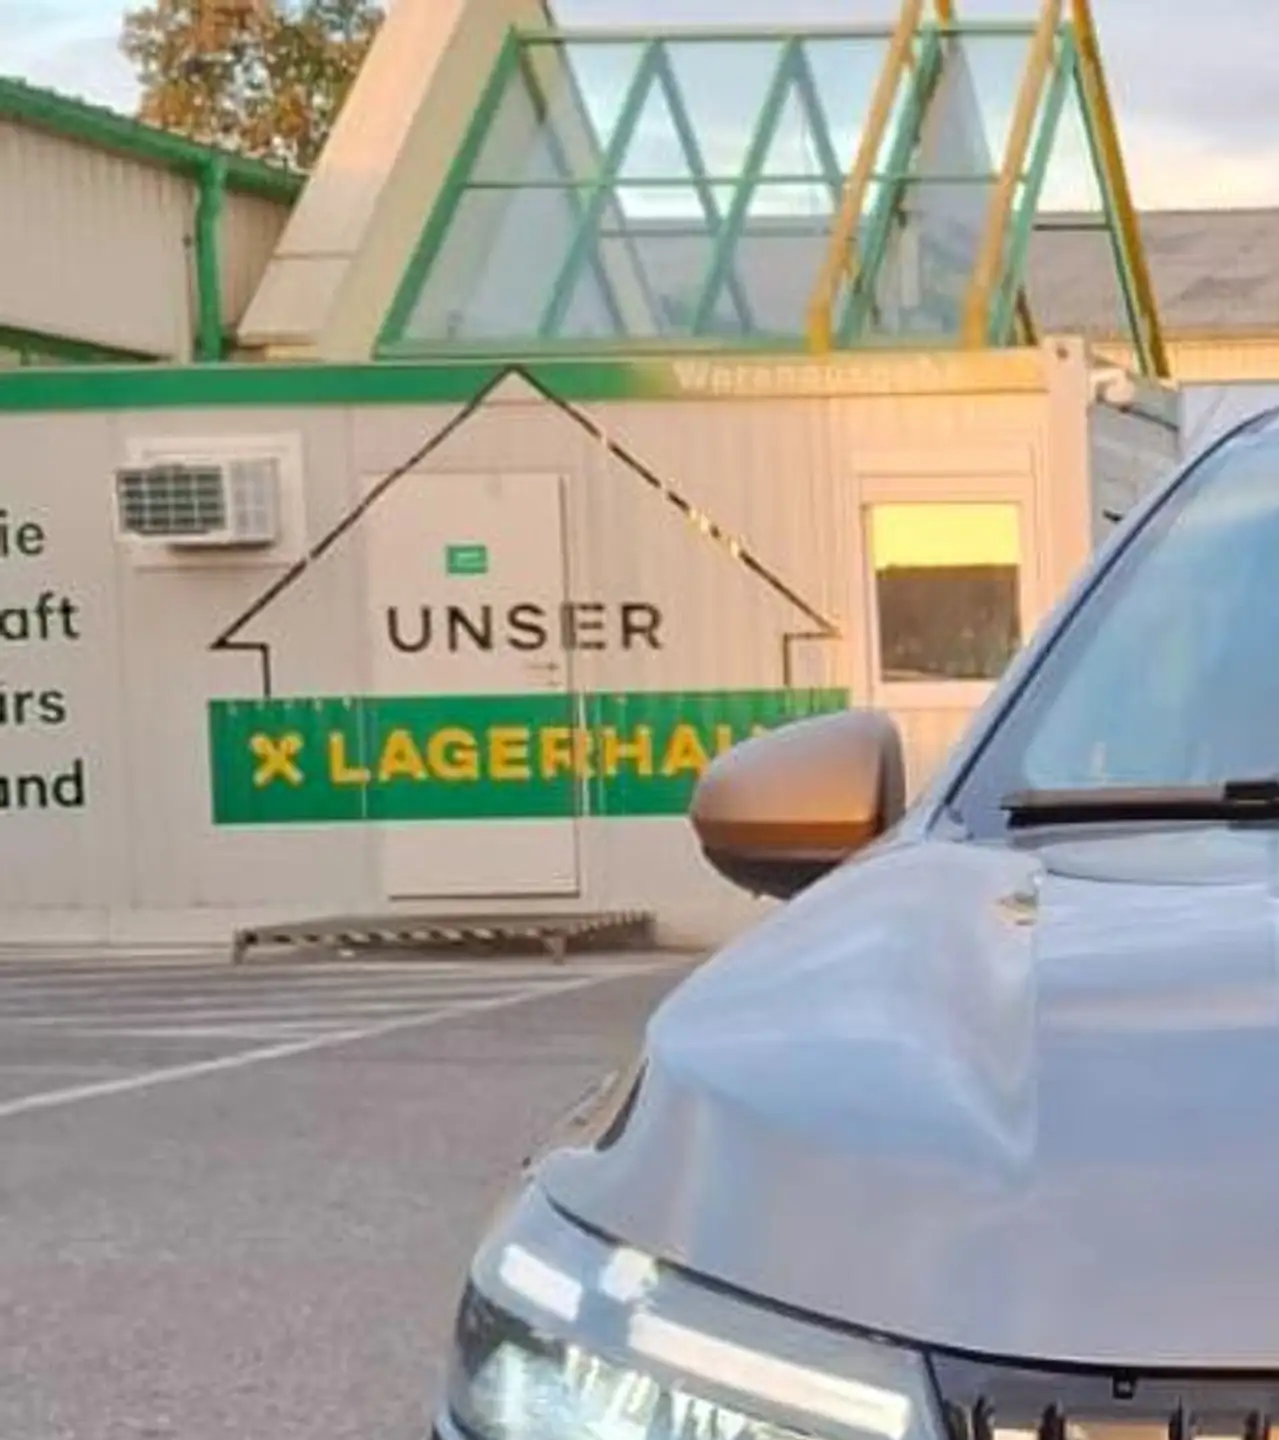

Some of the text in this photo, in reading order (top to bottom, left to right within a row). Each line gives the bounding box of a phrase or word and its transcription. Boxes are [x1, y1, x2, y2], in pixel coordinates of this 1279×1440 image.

[0, 591, 80, 640] aft
[387, 602, 664, 652] UNSER
[0, 689, 67, 726] rs
